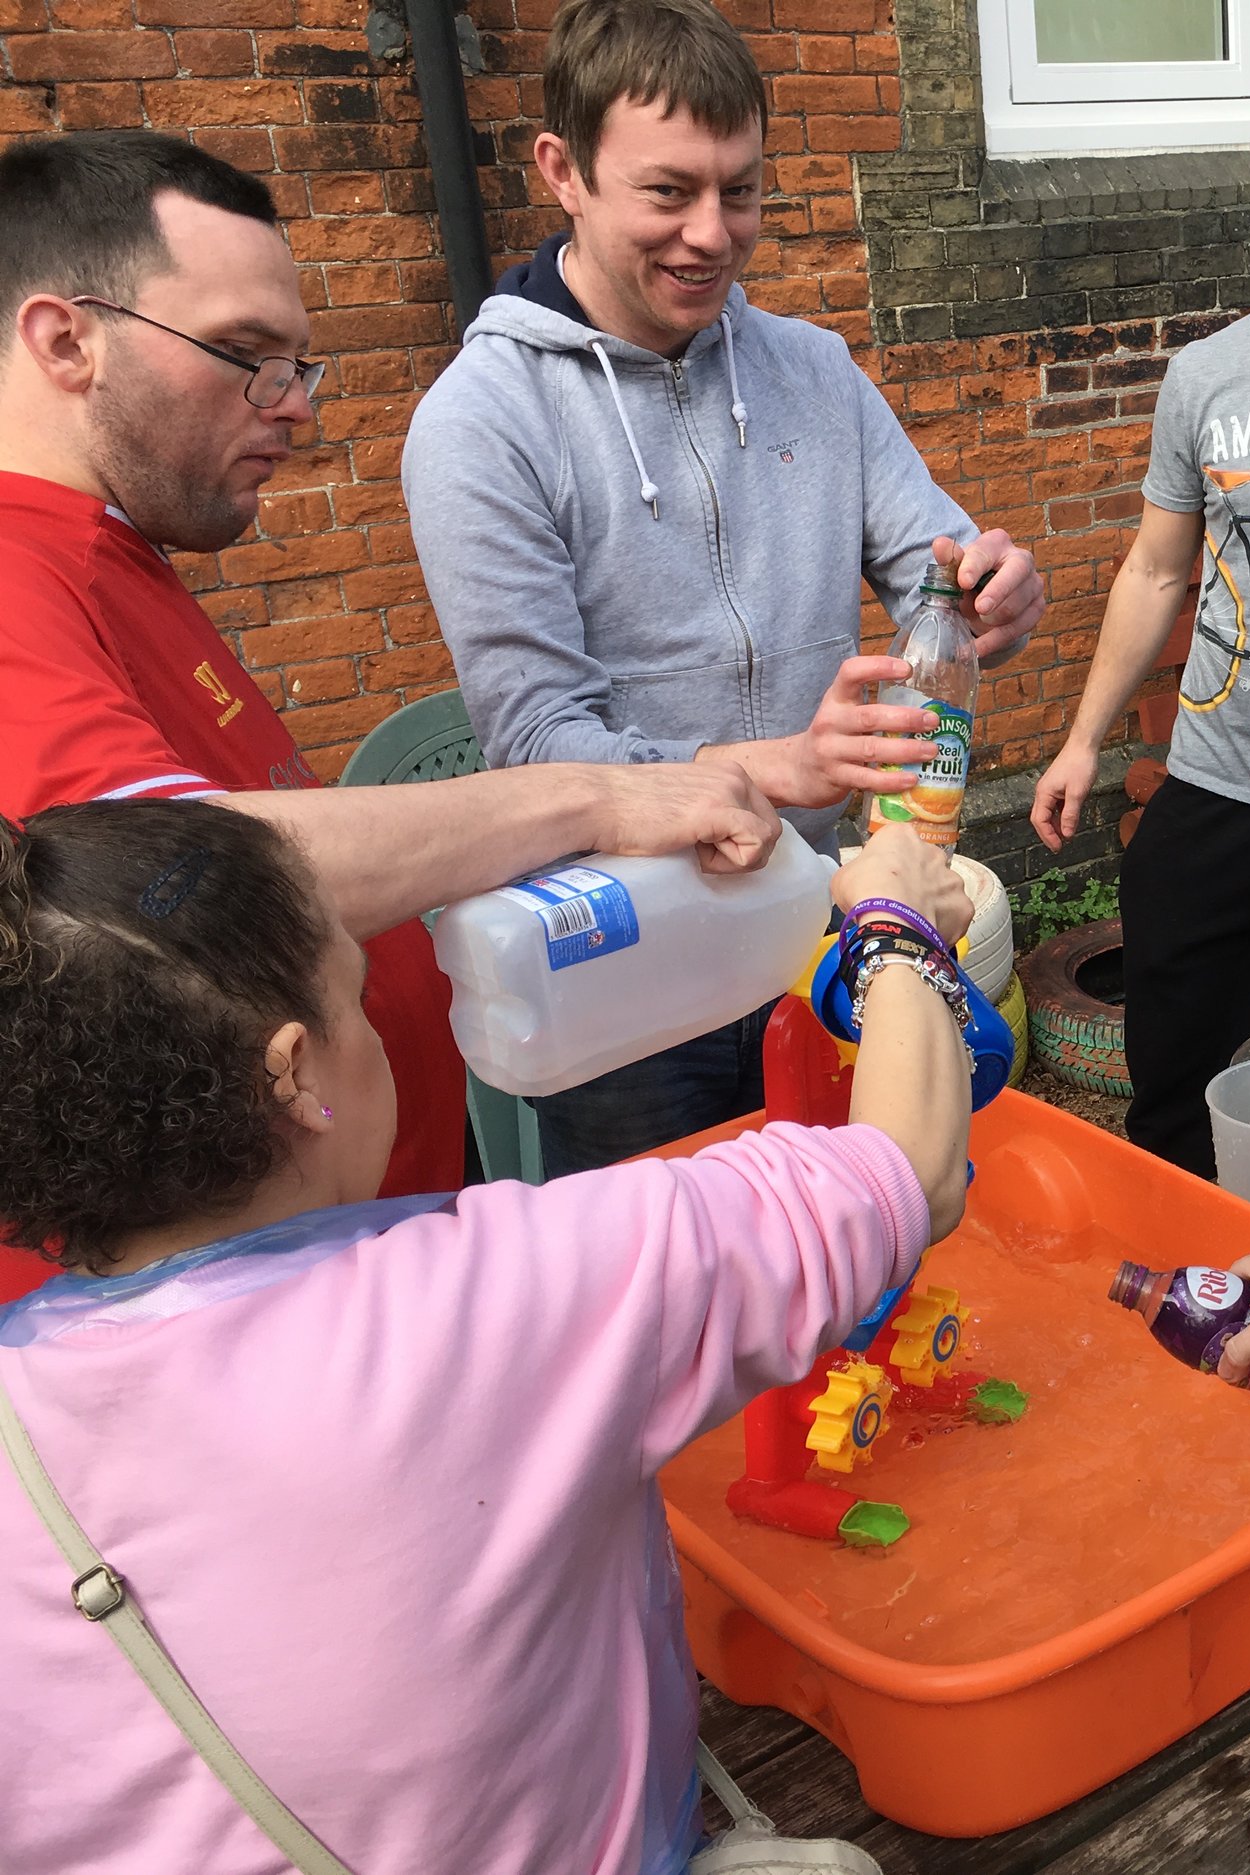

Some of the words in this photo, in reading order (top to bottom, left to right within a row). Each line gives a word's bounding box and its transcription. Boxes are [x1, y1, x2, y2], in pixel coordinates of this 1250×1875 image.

[936, 743, 961, 757] Real
[931, 775, 948, 783] every
[888, 902, 933, 934] disabilities
